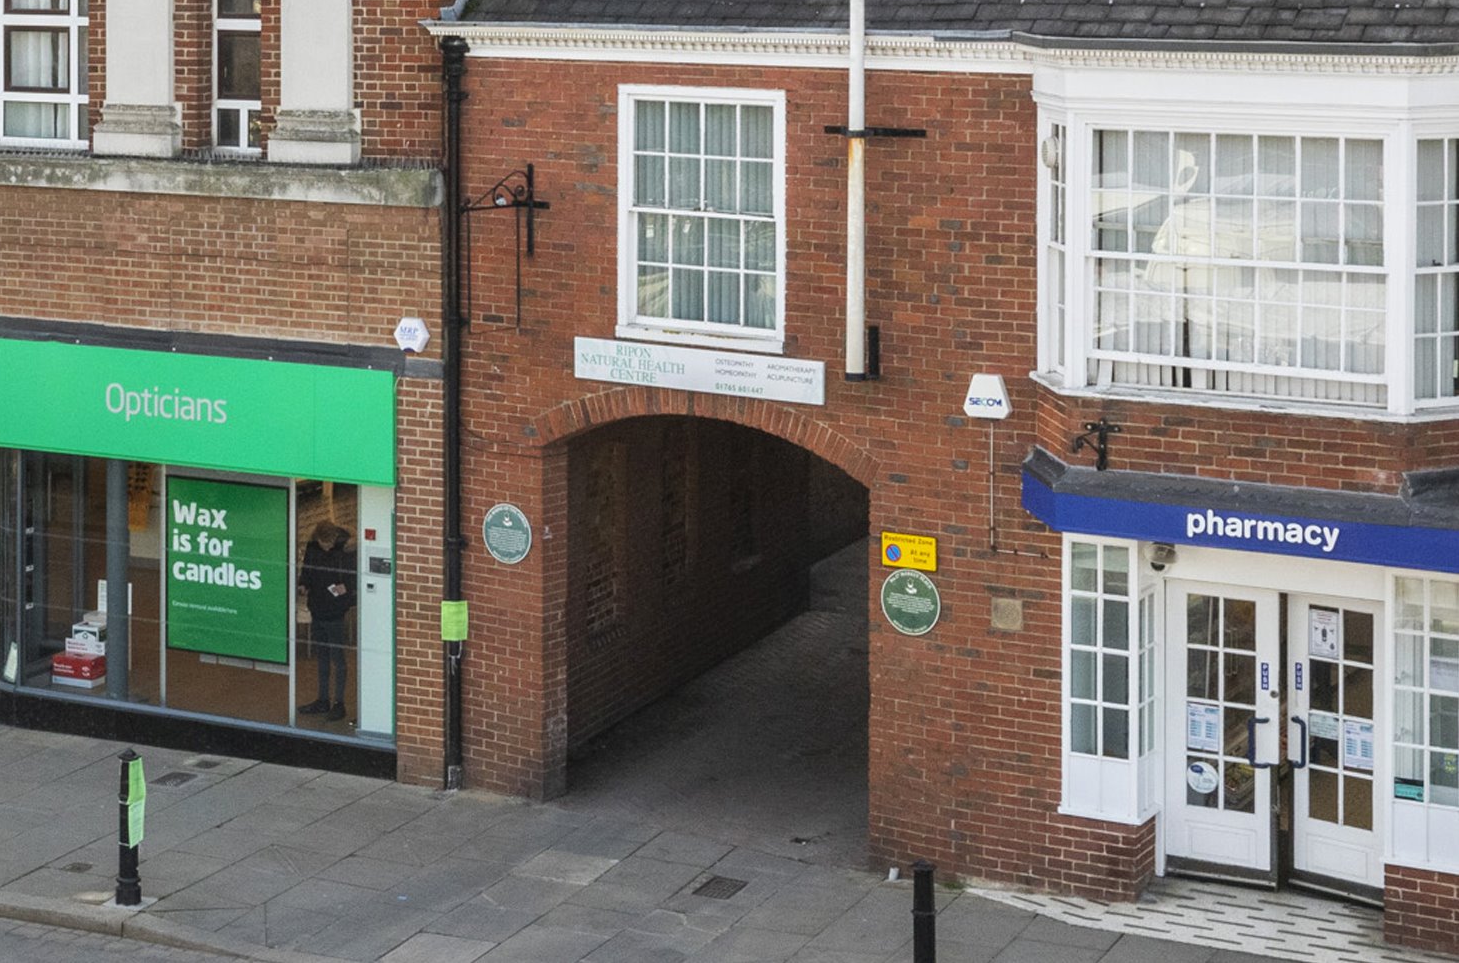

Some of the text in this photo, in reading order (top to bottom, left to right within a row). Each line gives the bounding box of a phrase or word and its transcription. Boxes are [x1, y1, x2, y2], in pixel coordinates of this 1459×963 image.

[615, 343, 652, 359] RIPON
[580, 351, 685, 376] NATURAL HEALTH
[714, 358, 816, 375] OSTEOPATHY AROMATHERAPY
[609, 366, 658, 384] CENTRE
[714, 368, 814, 385] HOMEOPATHY ACUPUNCTURE
[105, 383, 228, 424] Opticians
[969, 397, 1003, 407] SECOM
[172, 499, 228, 530] Wax
[884, 533, 933, 546] Restricted Zone
[1186, 508, 1340, 552] pharmacy
[172, 528, 234, 557] is for
[172, 561, 263, 591] candles
